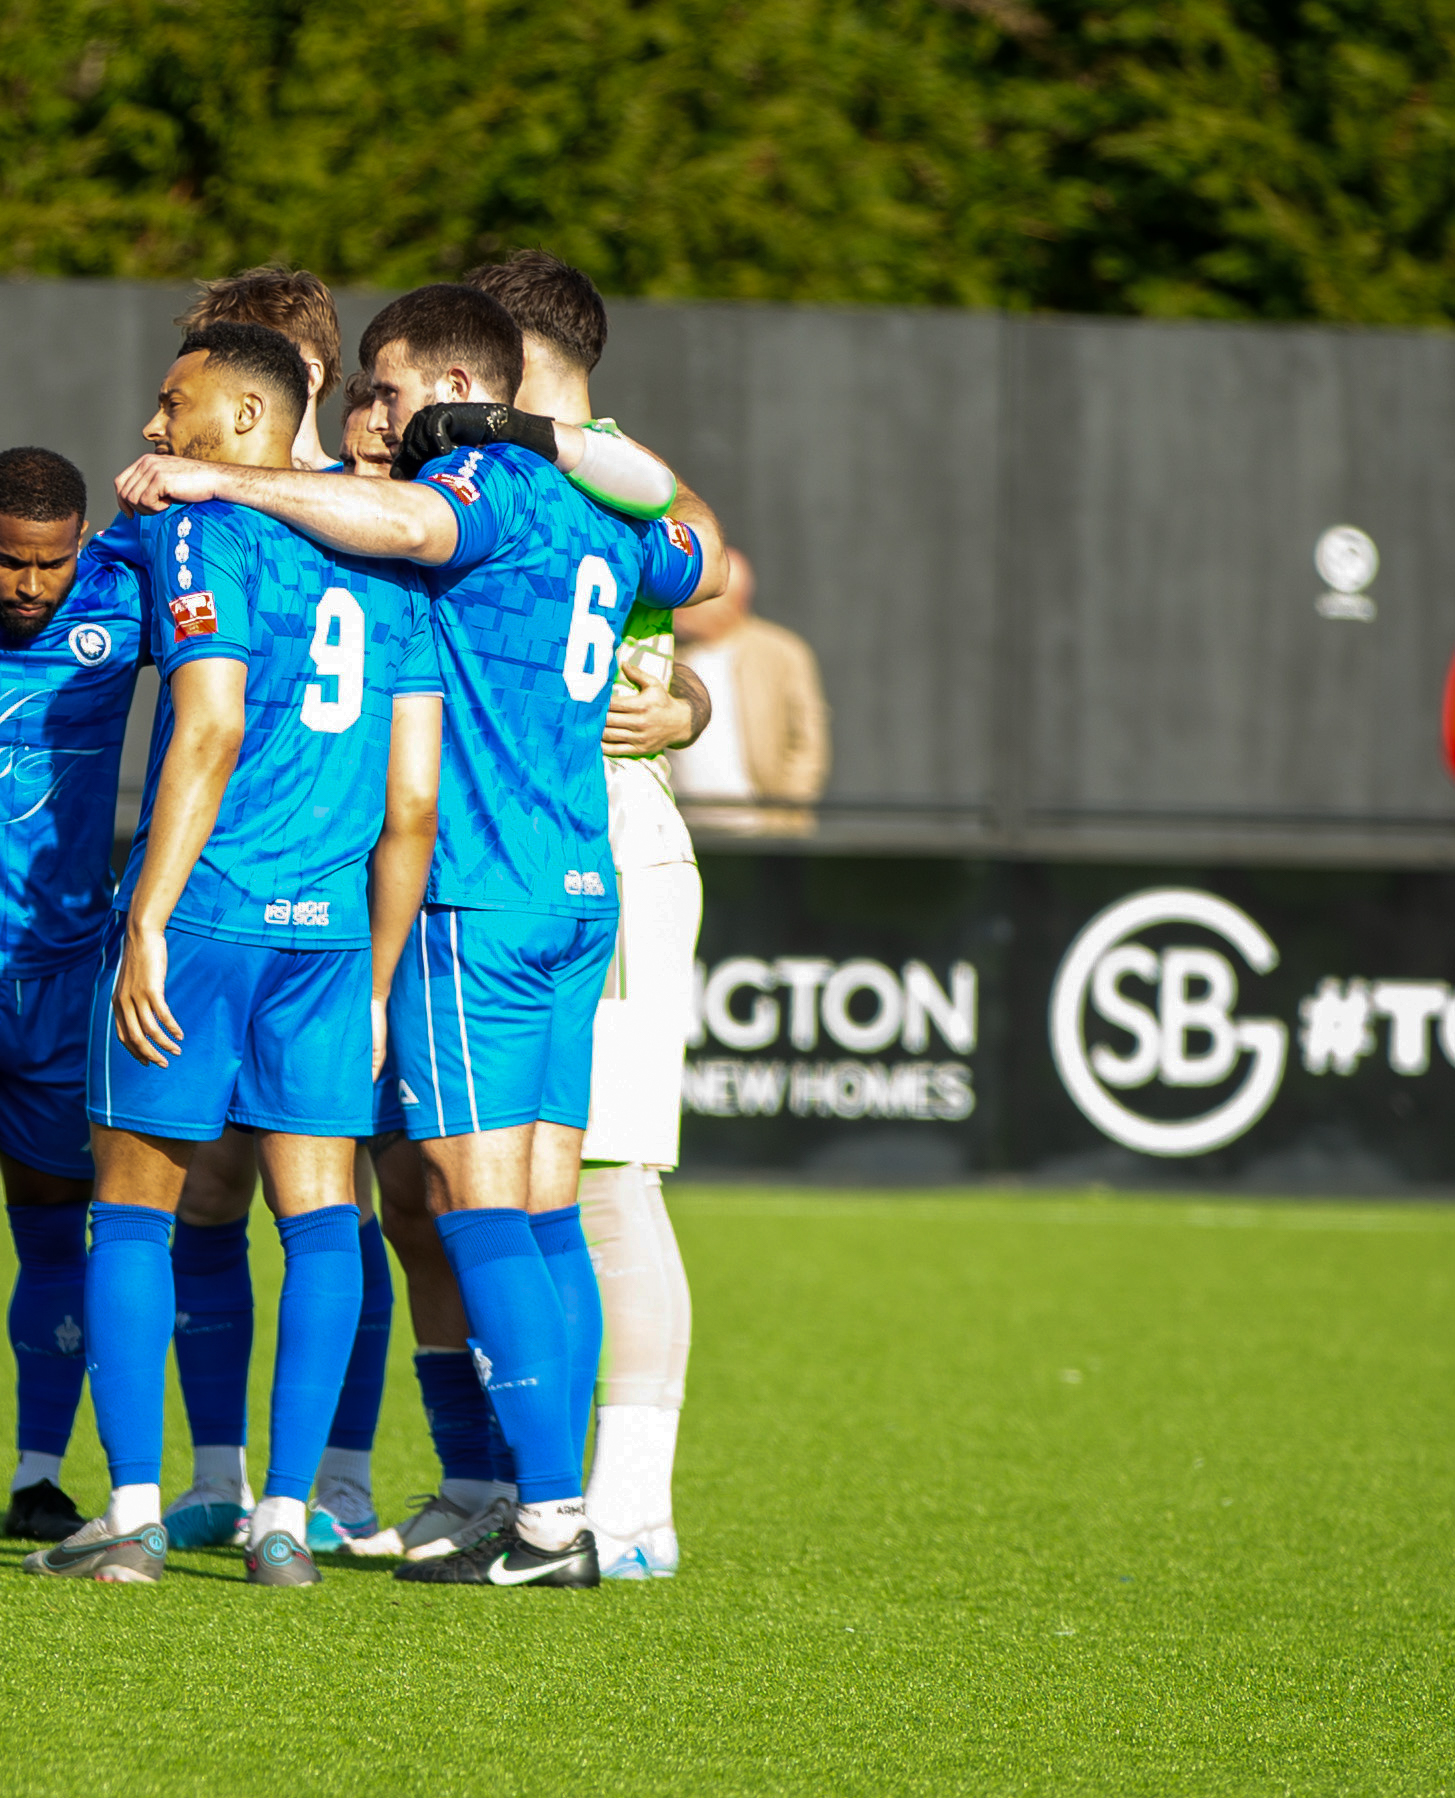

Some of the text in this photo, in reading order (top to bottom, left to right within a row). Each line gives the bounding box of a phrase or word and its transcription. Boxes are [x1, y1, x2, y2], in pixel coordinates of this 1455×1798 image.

[300, 586, 365, 733] 9
[562, 554, 617, 703] 6
[691, 957, 977, 1054] GTON
[1300, 979, 1455, 1075] #T
[788, 1062, 974, 1120] HOMES
